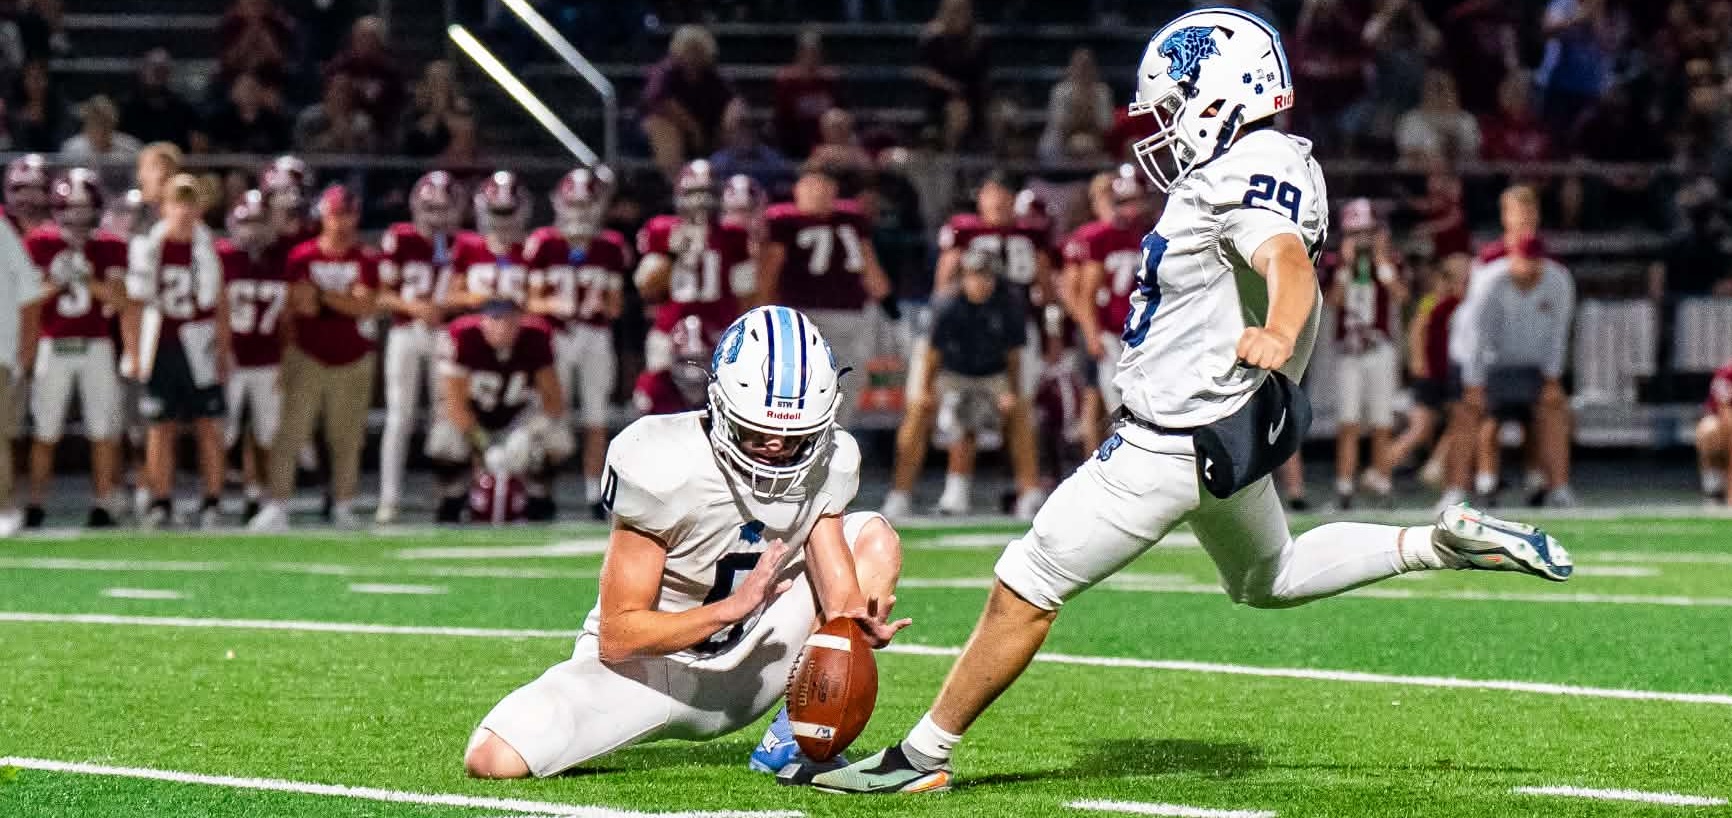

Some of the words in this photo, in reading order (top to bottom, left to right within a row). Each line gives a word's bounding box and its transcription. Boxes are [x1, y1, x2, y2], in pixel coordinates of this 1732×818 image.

[1243, 173, 1302, 224] 29
[797, 225, 865, 275] 71
[766, 410, 801, 420] Riddell
